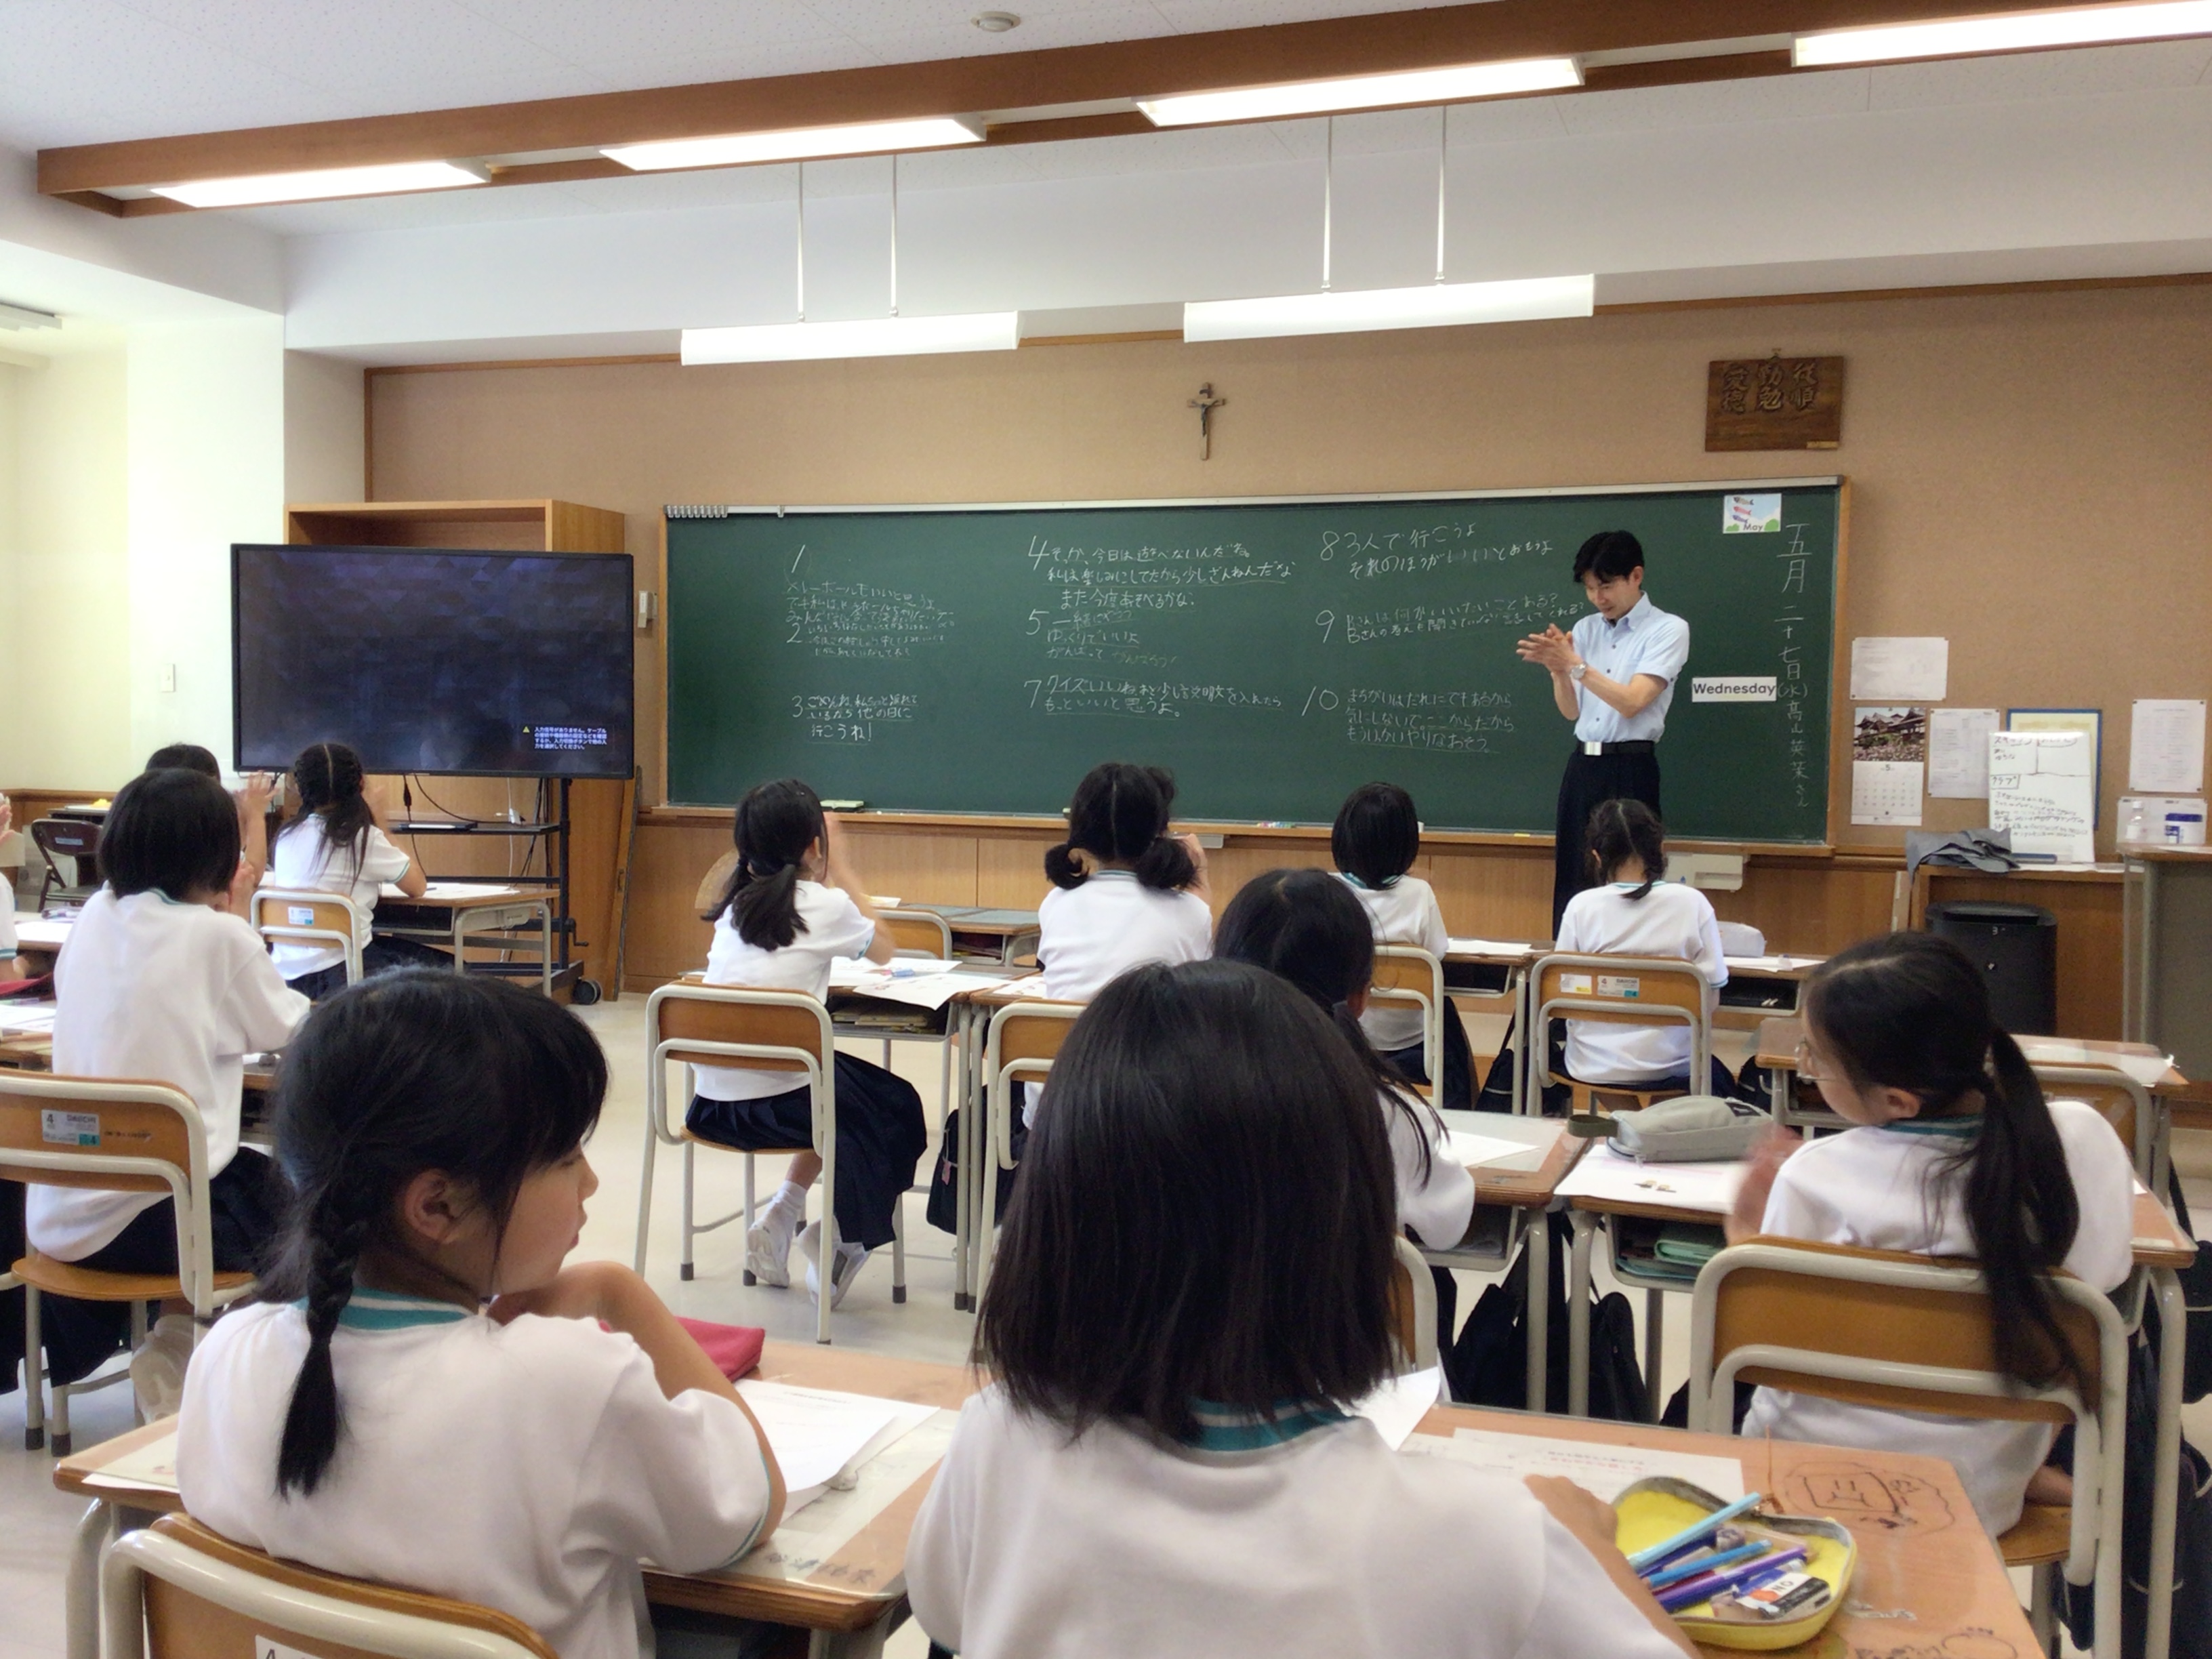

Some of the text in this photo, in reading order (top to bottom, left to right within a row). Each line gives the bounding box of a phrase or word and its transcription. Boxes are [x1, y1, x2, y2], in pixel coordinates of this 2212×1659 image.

[1744, 523, 1763, 531] May
[1028, 535, 1050, 571] 4
[1320, 531, 1340, 561] 8
[786, 622, 802, 643] 2
[1025, 609, 1050, 636] 5
[1315, 610, 1335, 643] 9
[1023, 679, 1042, 708] 7
[1301, 685, 1339, 717] 10
[1694, 683, 1776, 696] Wednesday
[792, 695, 804, 718] 3
[47, 1113, 54, 1124] 4
